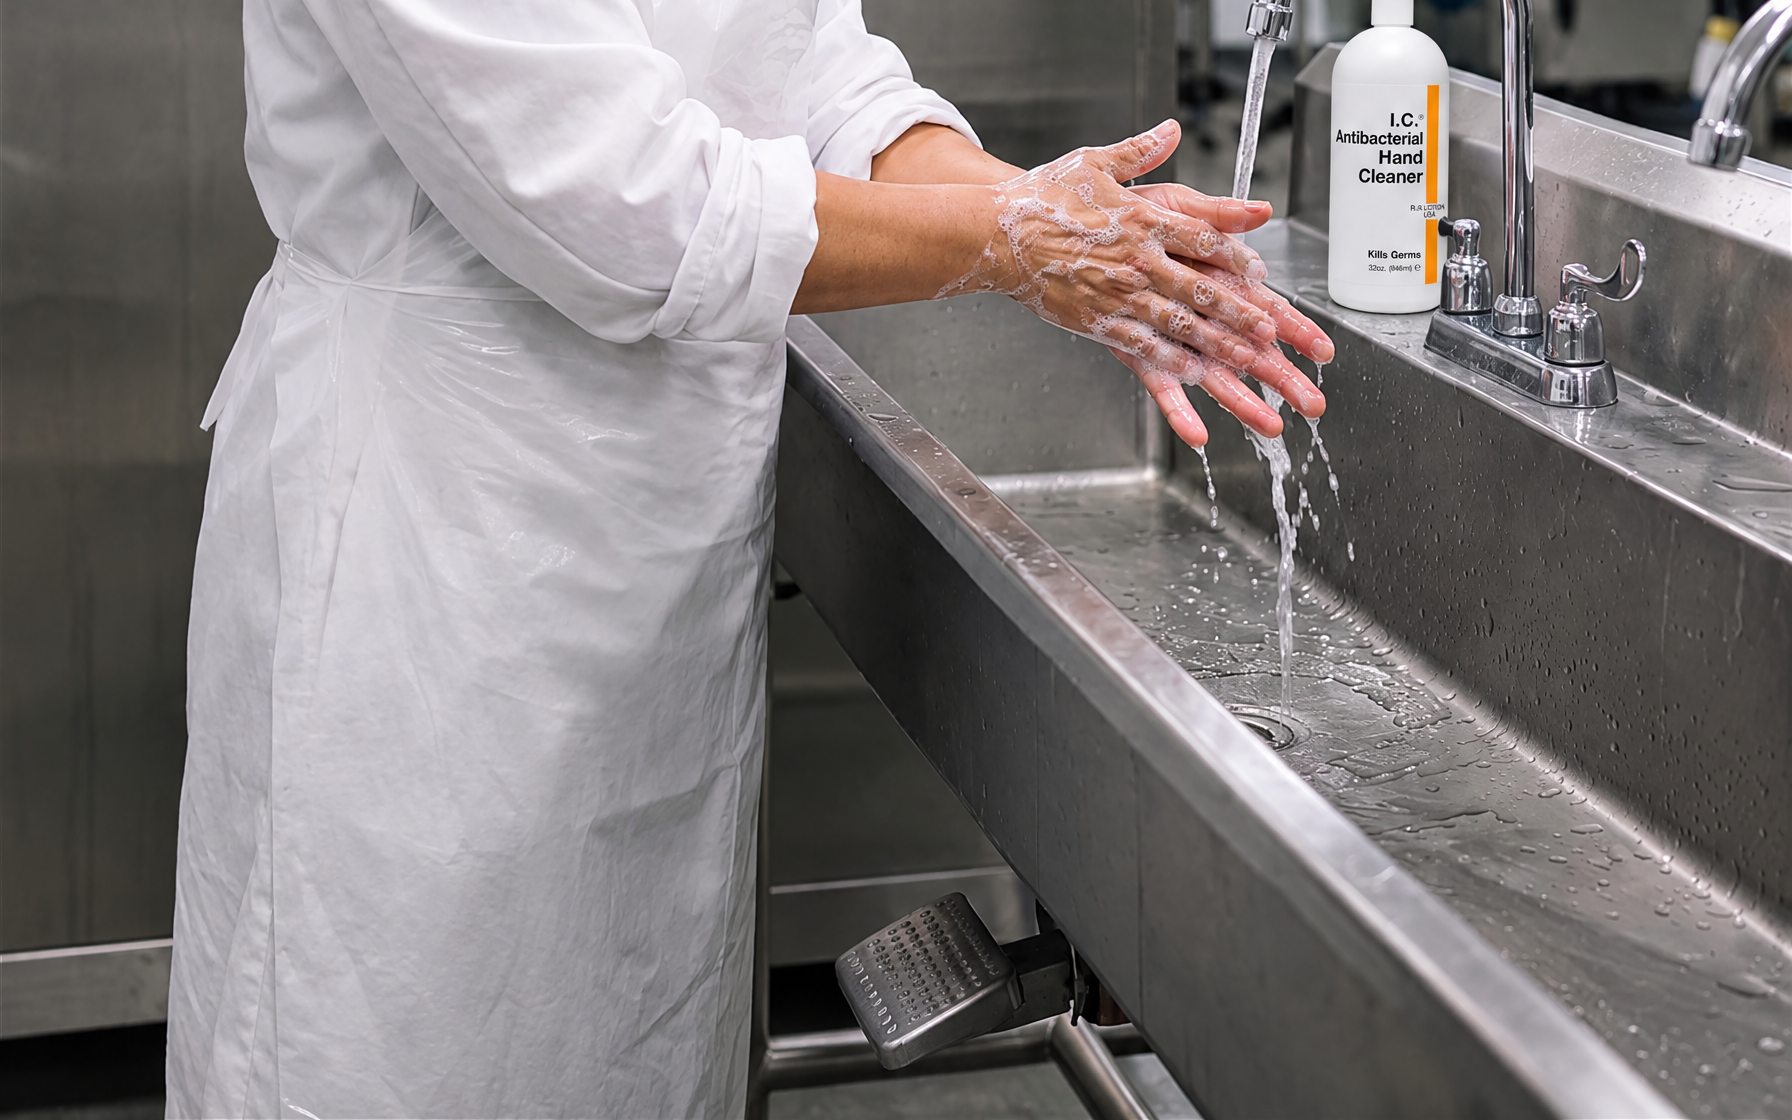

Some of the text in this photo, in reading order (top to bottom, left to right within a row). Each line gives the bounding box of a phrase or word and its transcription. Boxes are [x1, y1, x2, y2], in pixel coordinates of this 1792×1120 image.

[1335, 129, 1424, 145] Antibacterial
[1378, 149, 1423, 165] Hand
[1358, 168, 1424, 184] Cleaner
[1368, 249, 1421, 259] Kills Germs
[1368, 264, 1386, 272] 32oz.
